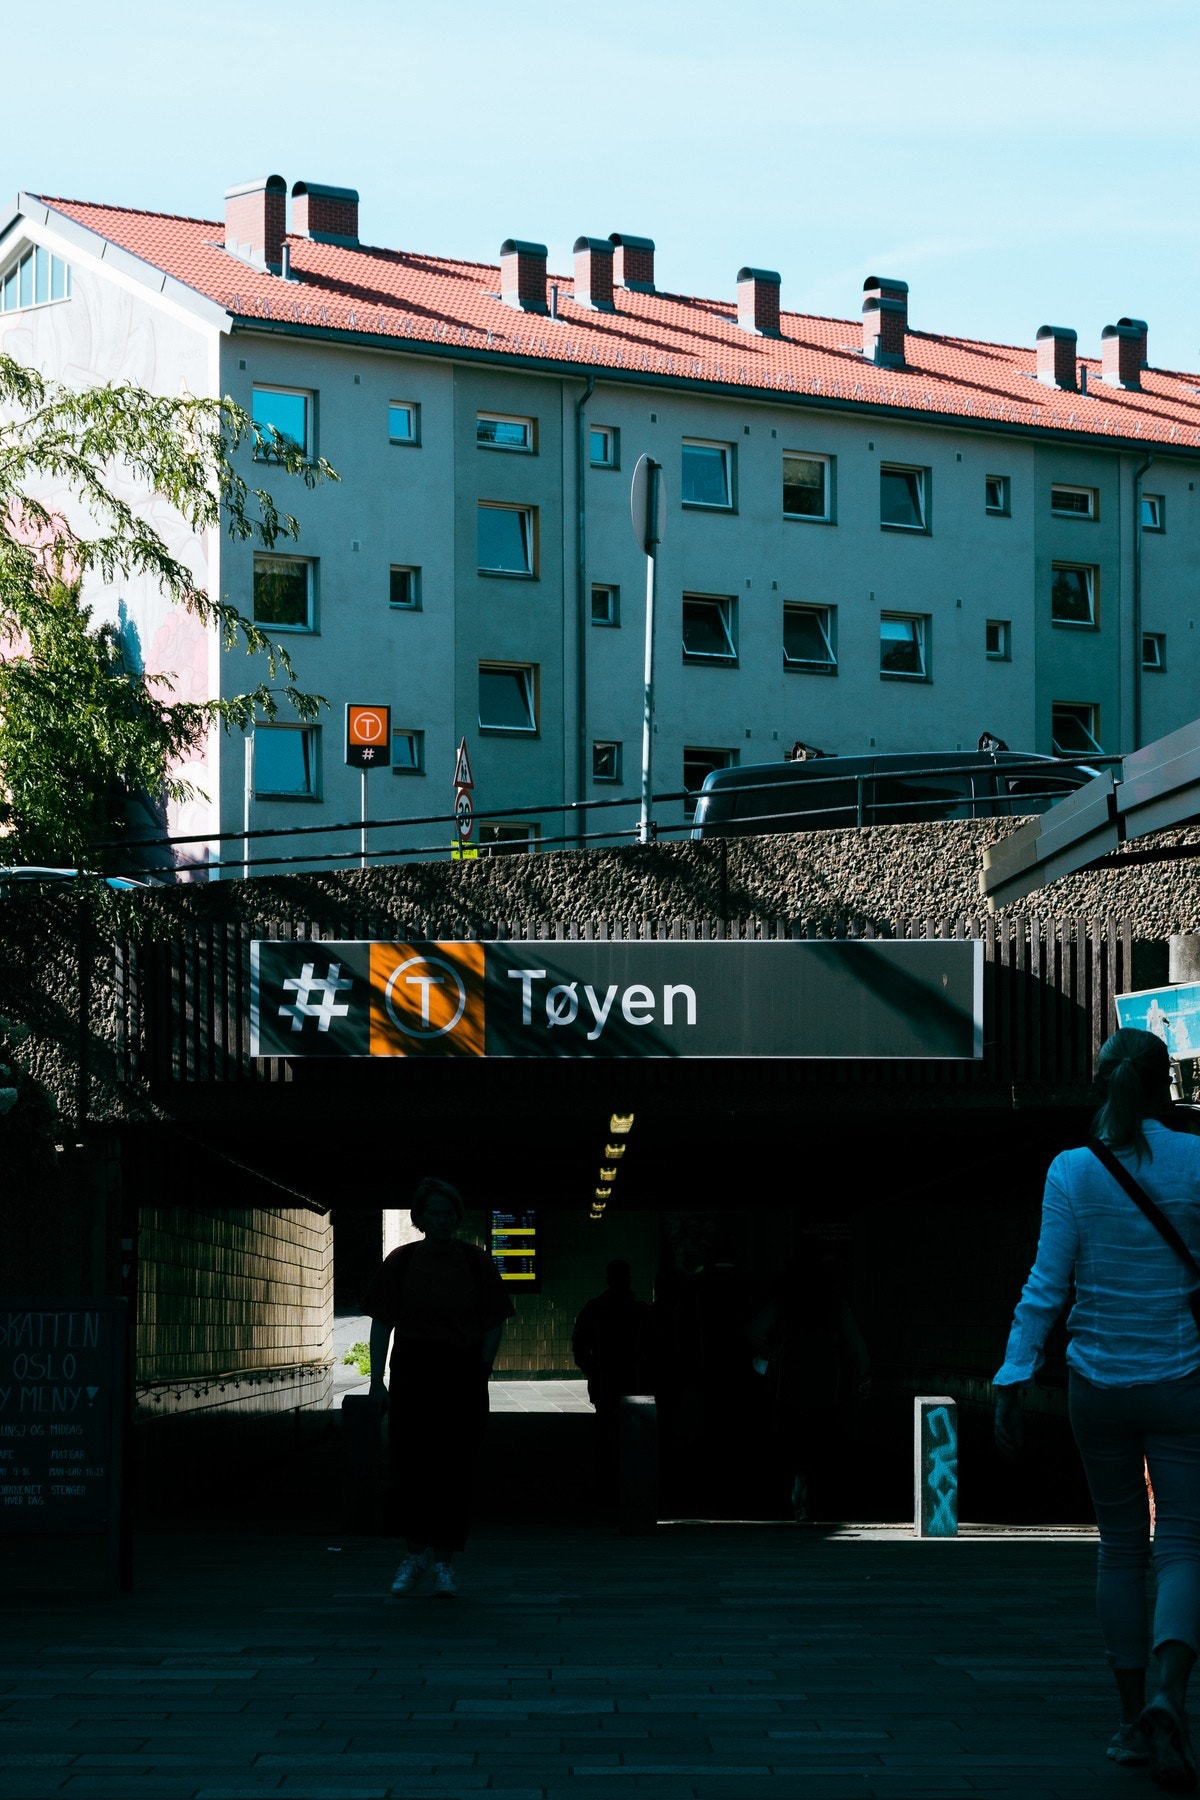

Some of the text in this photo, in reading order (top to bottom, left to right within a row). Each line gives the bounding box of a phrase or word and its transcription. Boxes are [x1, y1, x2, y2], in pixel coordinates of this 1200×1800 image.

[459, 802, 470, 828] 30
[507, 969, 697, 1041] Tøyen
[13, 1353, 76, 1380] OSLO
[30, 1424, 44, 1436] OG
[50, 1424, 83, 1436] MIDDAG
